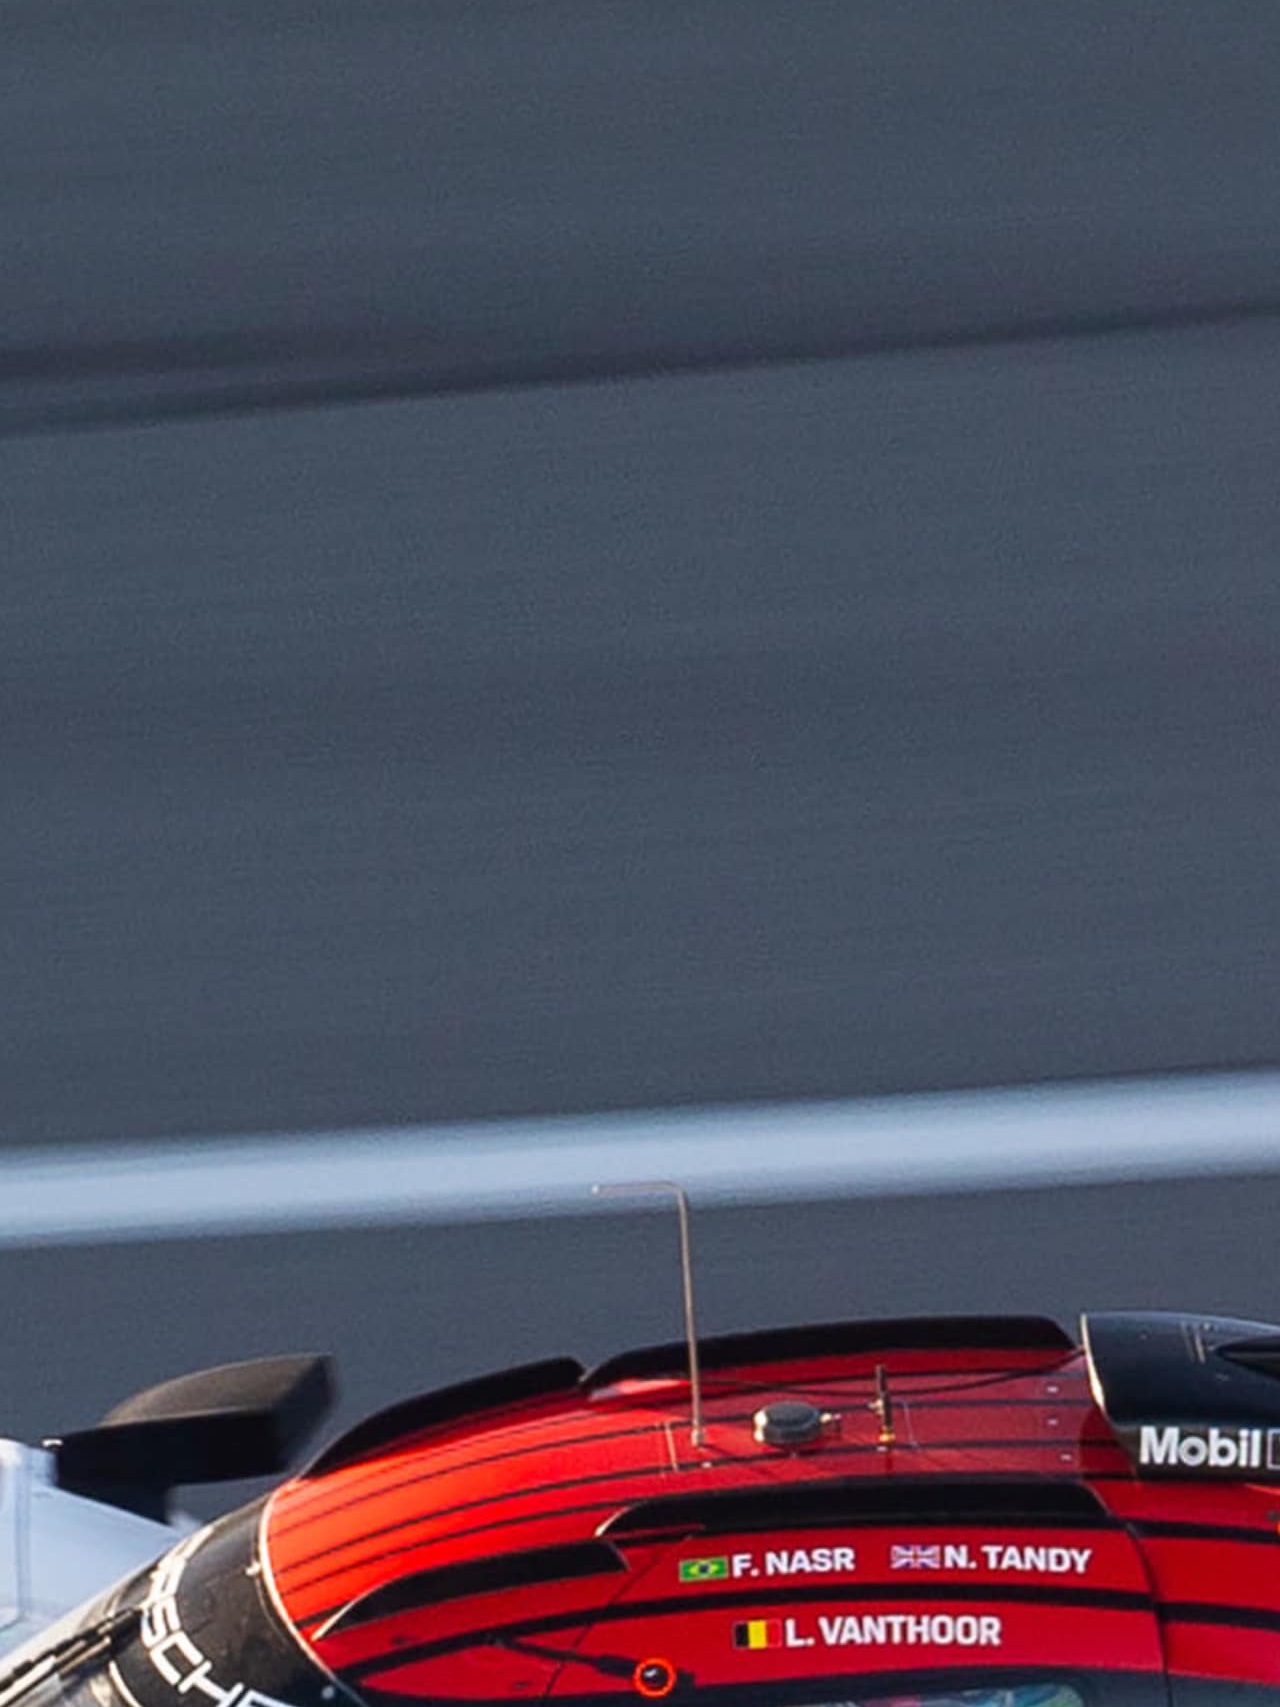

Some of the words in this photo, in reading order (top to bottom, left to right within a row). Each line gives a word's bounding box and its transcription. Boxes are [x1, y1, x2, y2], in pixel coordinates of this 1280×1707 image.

[1139, 1425, 1262, 1468] Mobil
[731, 1553, 759, 1578] F.
[766, 1547, 856, 1576] NASR
[944, 1545, 977, 1570] N.
[981, 1544, 1092, 1574] TANDY
[785, 1618, 815, 1648] L.
[820, 1614, 1002, 1647] VANTHOOR
